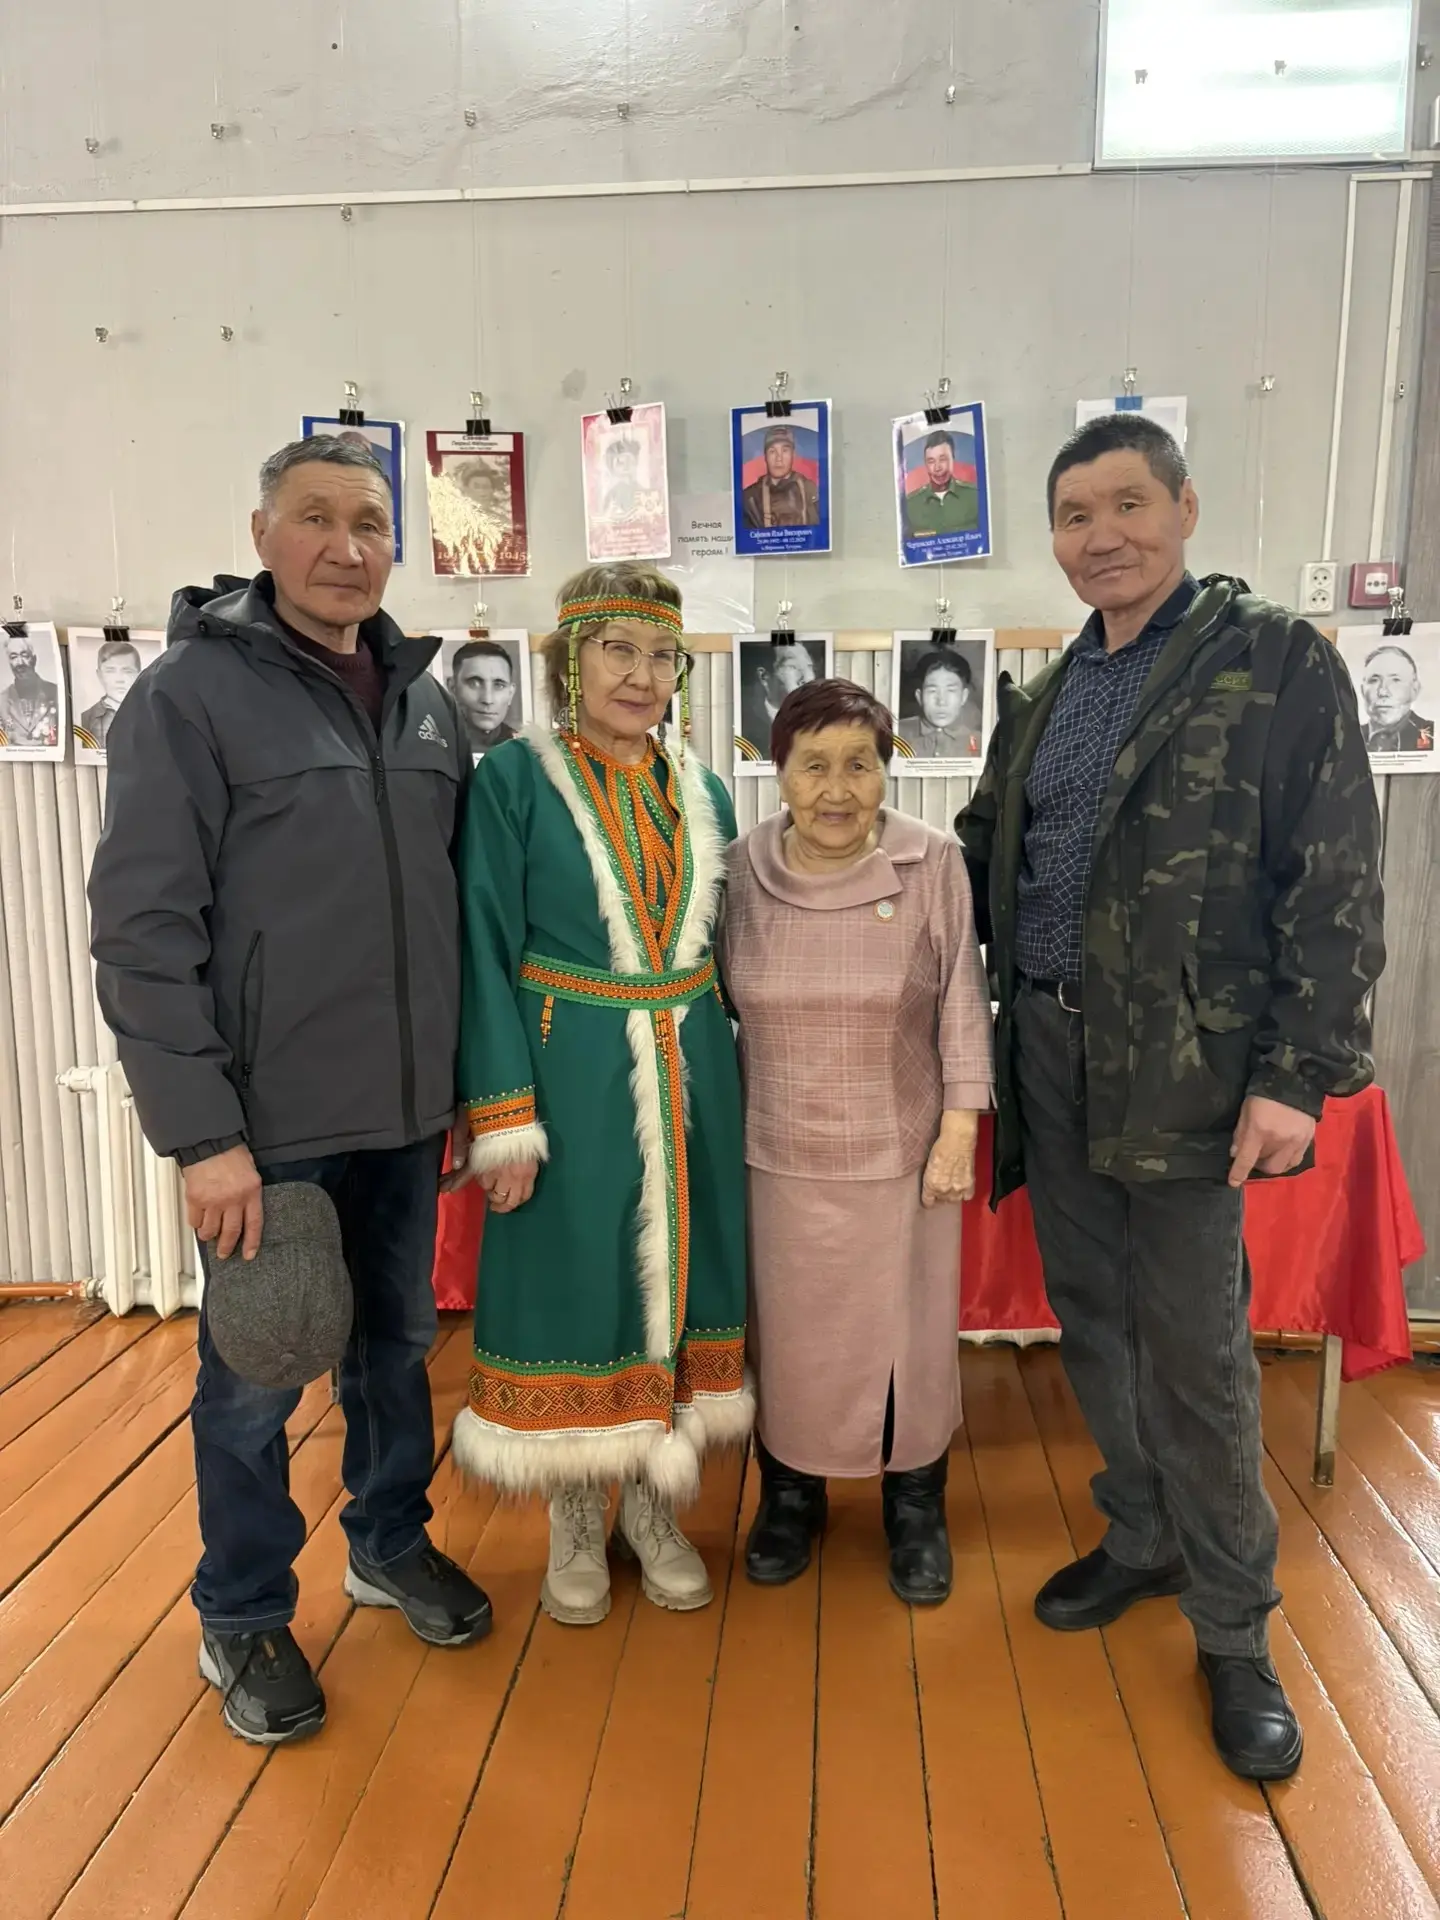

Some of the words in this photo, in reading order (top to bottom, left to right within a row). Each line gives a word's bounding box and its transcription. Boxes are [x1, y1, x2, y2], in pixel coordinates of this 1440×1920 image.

[691, 520, 722, 530] Вечная
[677, 535, 709, 543] память
[711, 535, 734, 543] наши
[691, 549, 724, 558] героям
